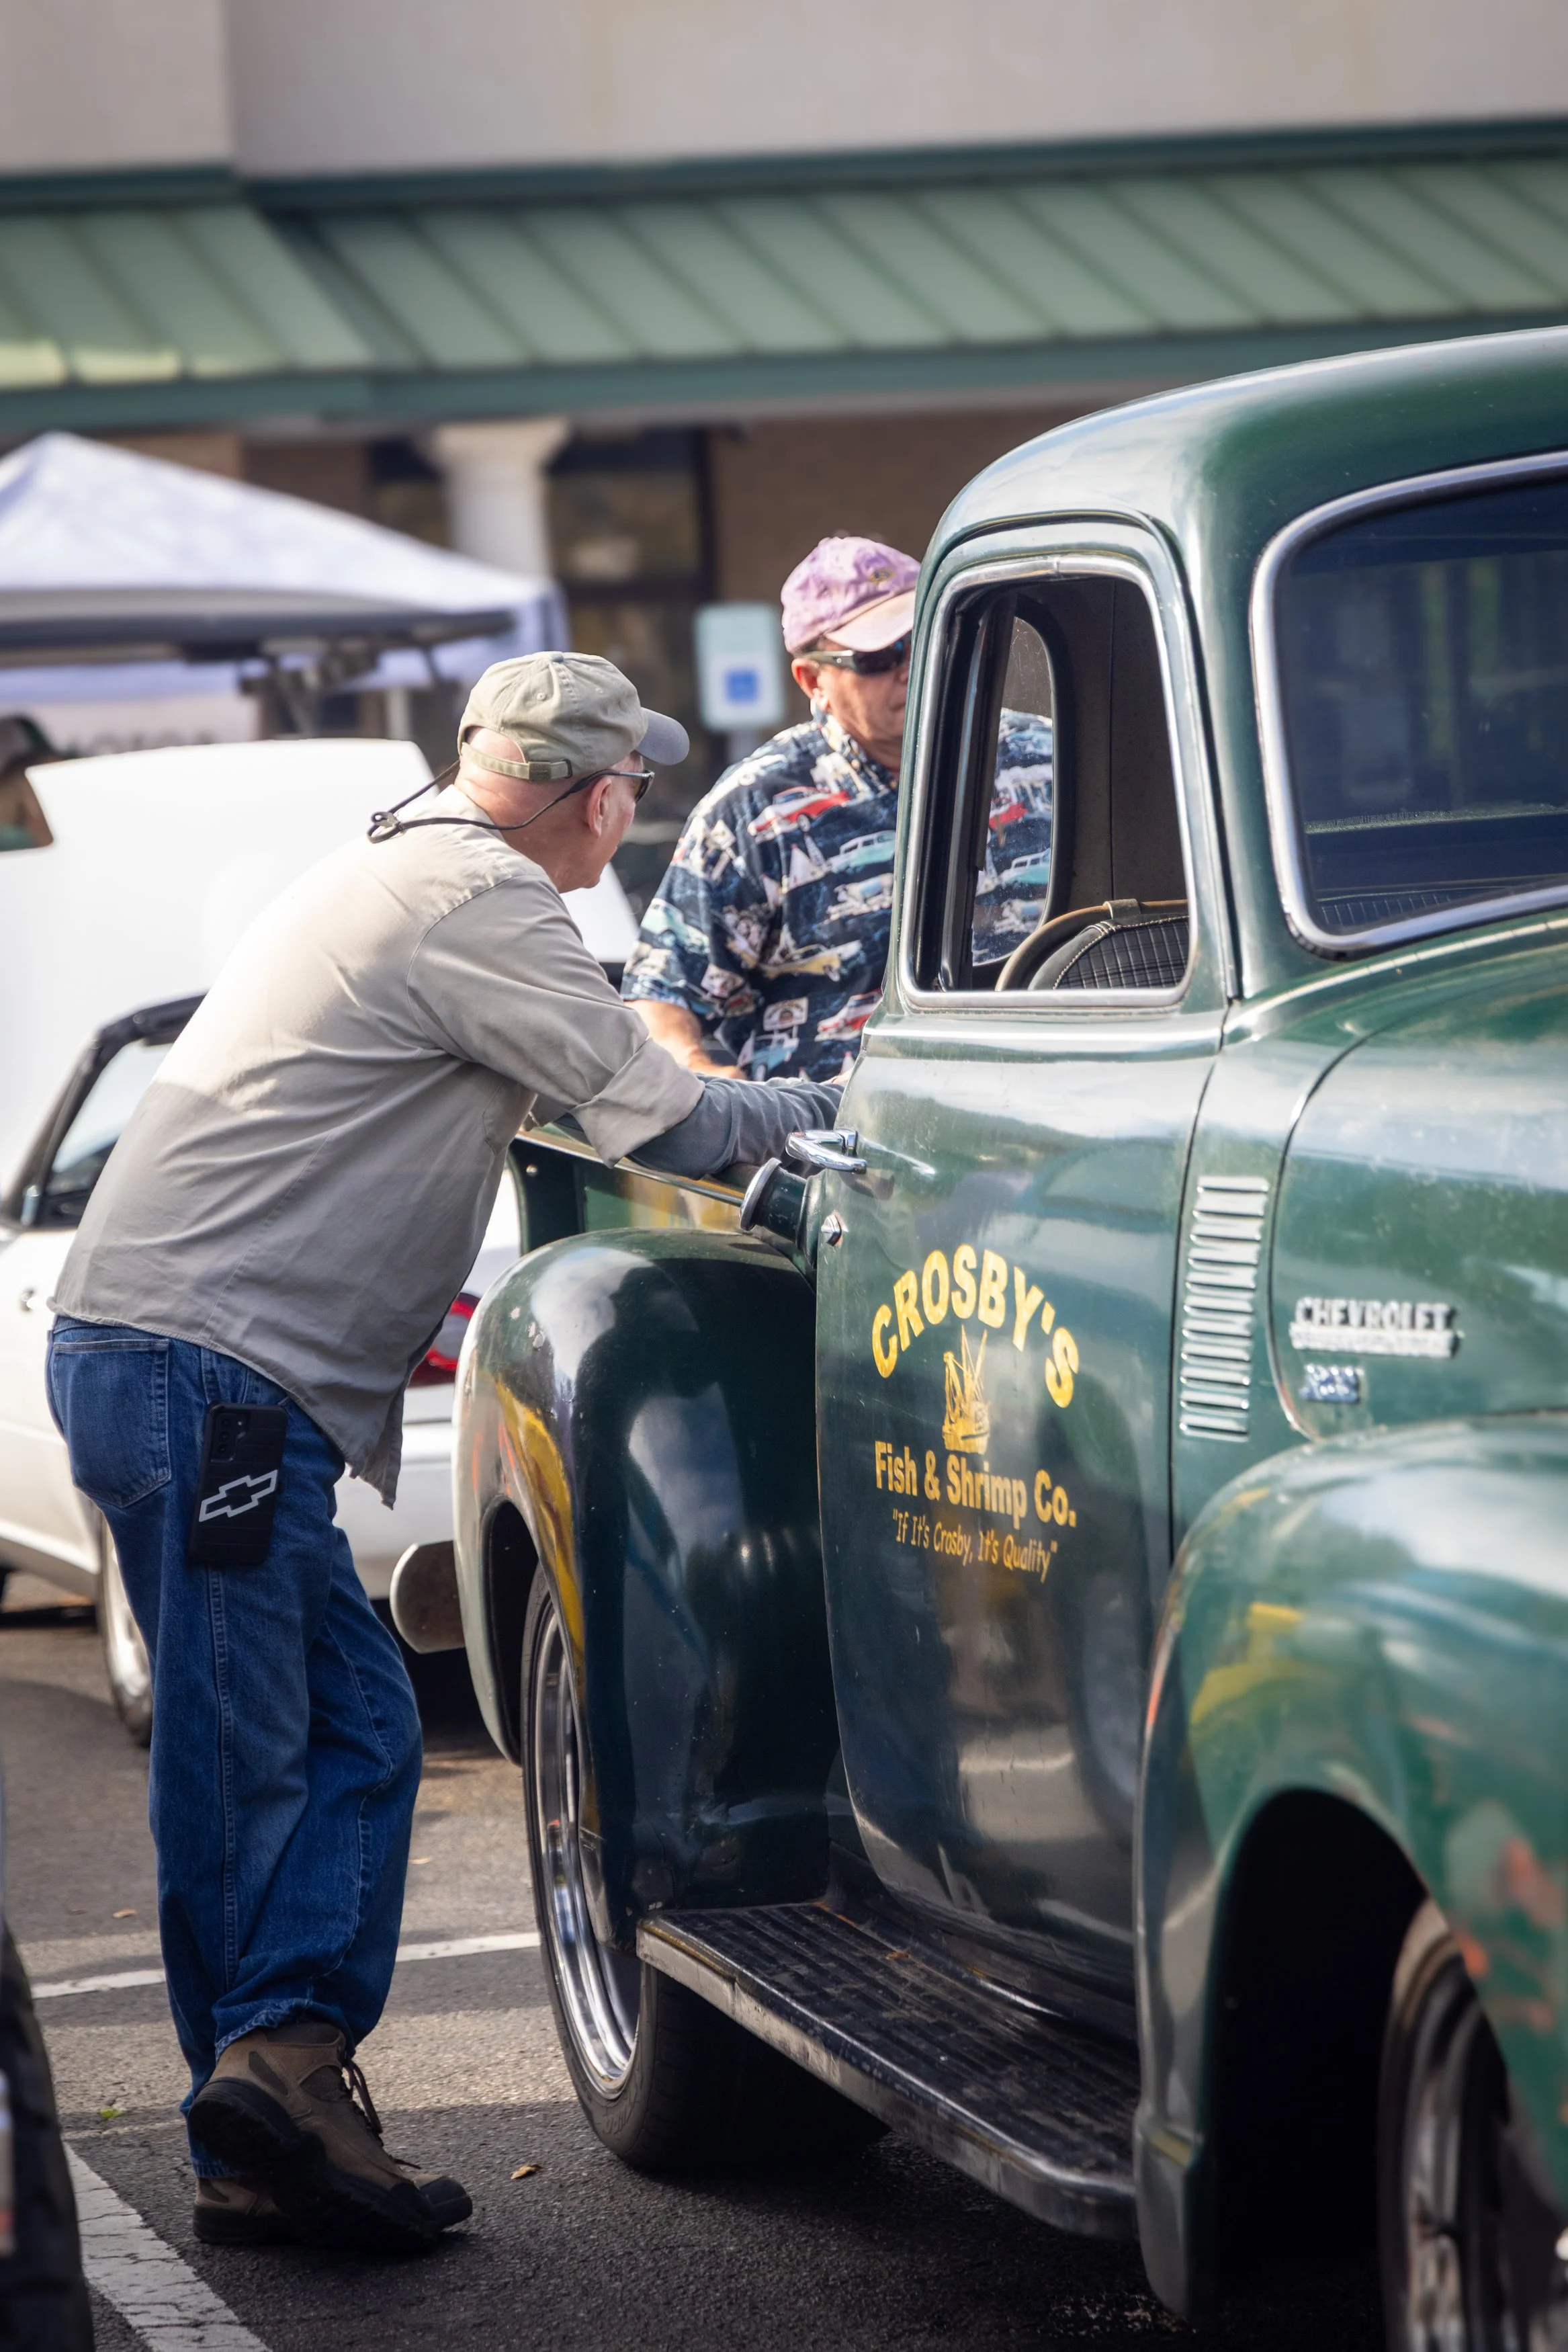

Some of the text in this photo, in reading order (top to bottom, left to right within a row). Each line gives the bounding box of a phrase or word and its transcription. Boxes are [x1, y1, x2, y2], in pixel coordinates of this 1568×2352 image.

[872, 1244, 1079, 1409] CROSBY'S
[1295, 1297, 1451, 1332] CHEVROLET
[875, 1440, 1077, 1531] Fish & Shrimp Co.
[892, 1508, 1059, 1583] "If It's Crosby, It's Quality"
